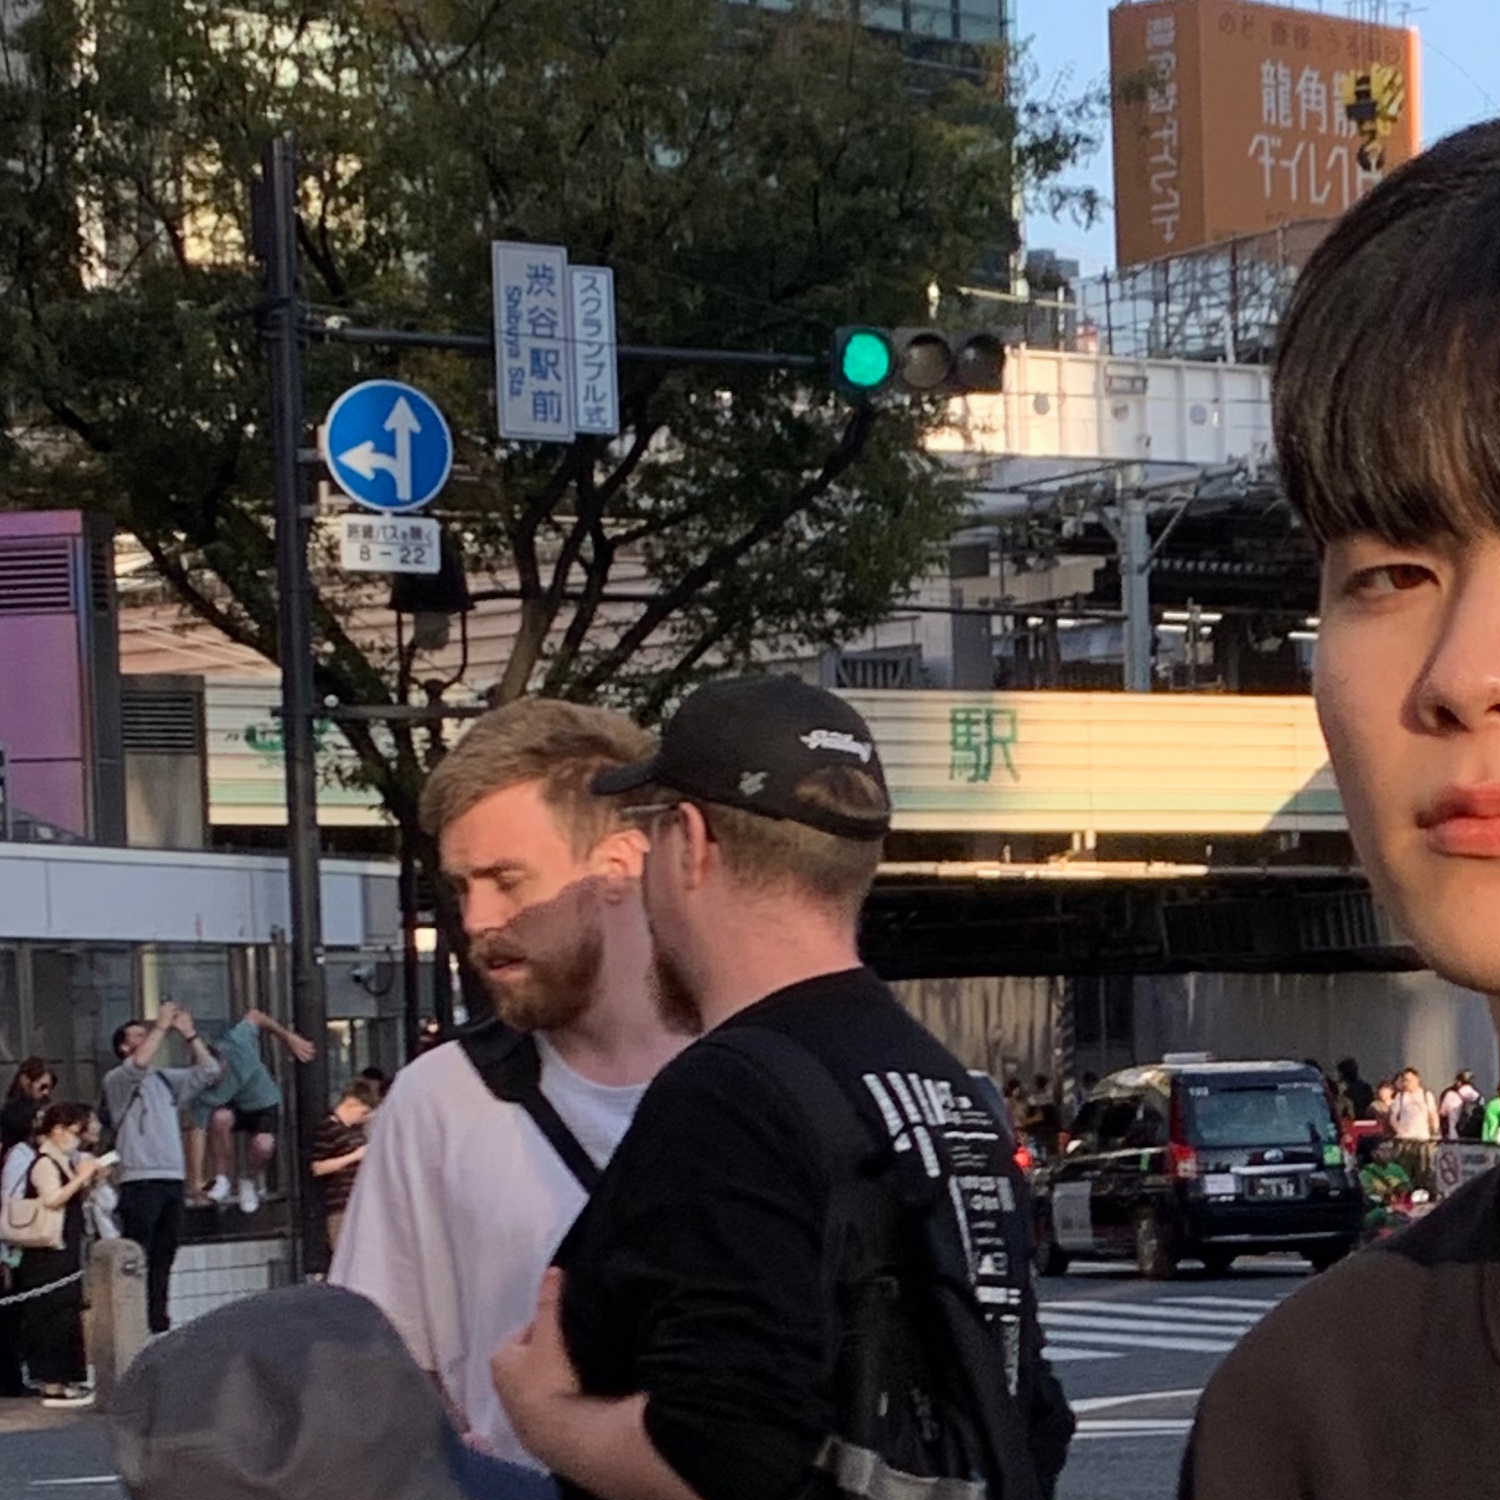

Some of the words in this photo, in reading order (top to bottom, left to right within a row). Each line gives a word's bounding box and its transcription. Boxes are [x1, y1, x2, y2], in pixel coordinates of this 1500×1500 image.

[526, 262, 563, 424] 渋谷駅前
[579, 274, 608, 426] スクランブル式
[948, 706, 1021, 784] 駅
